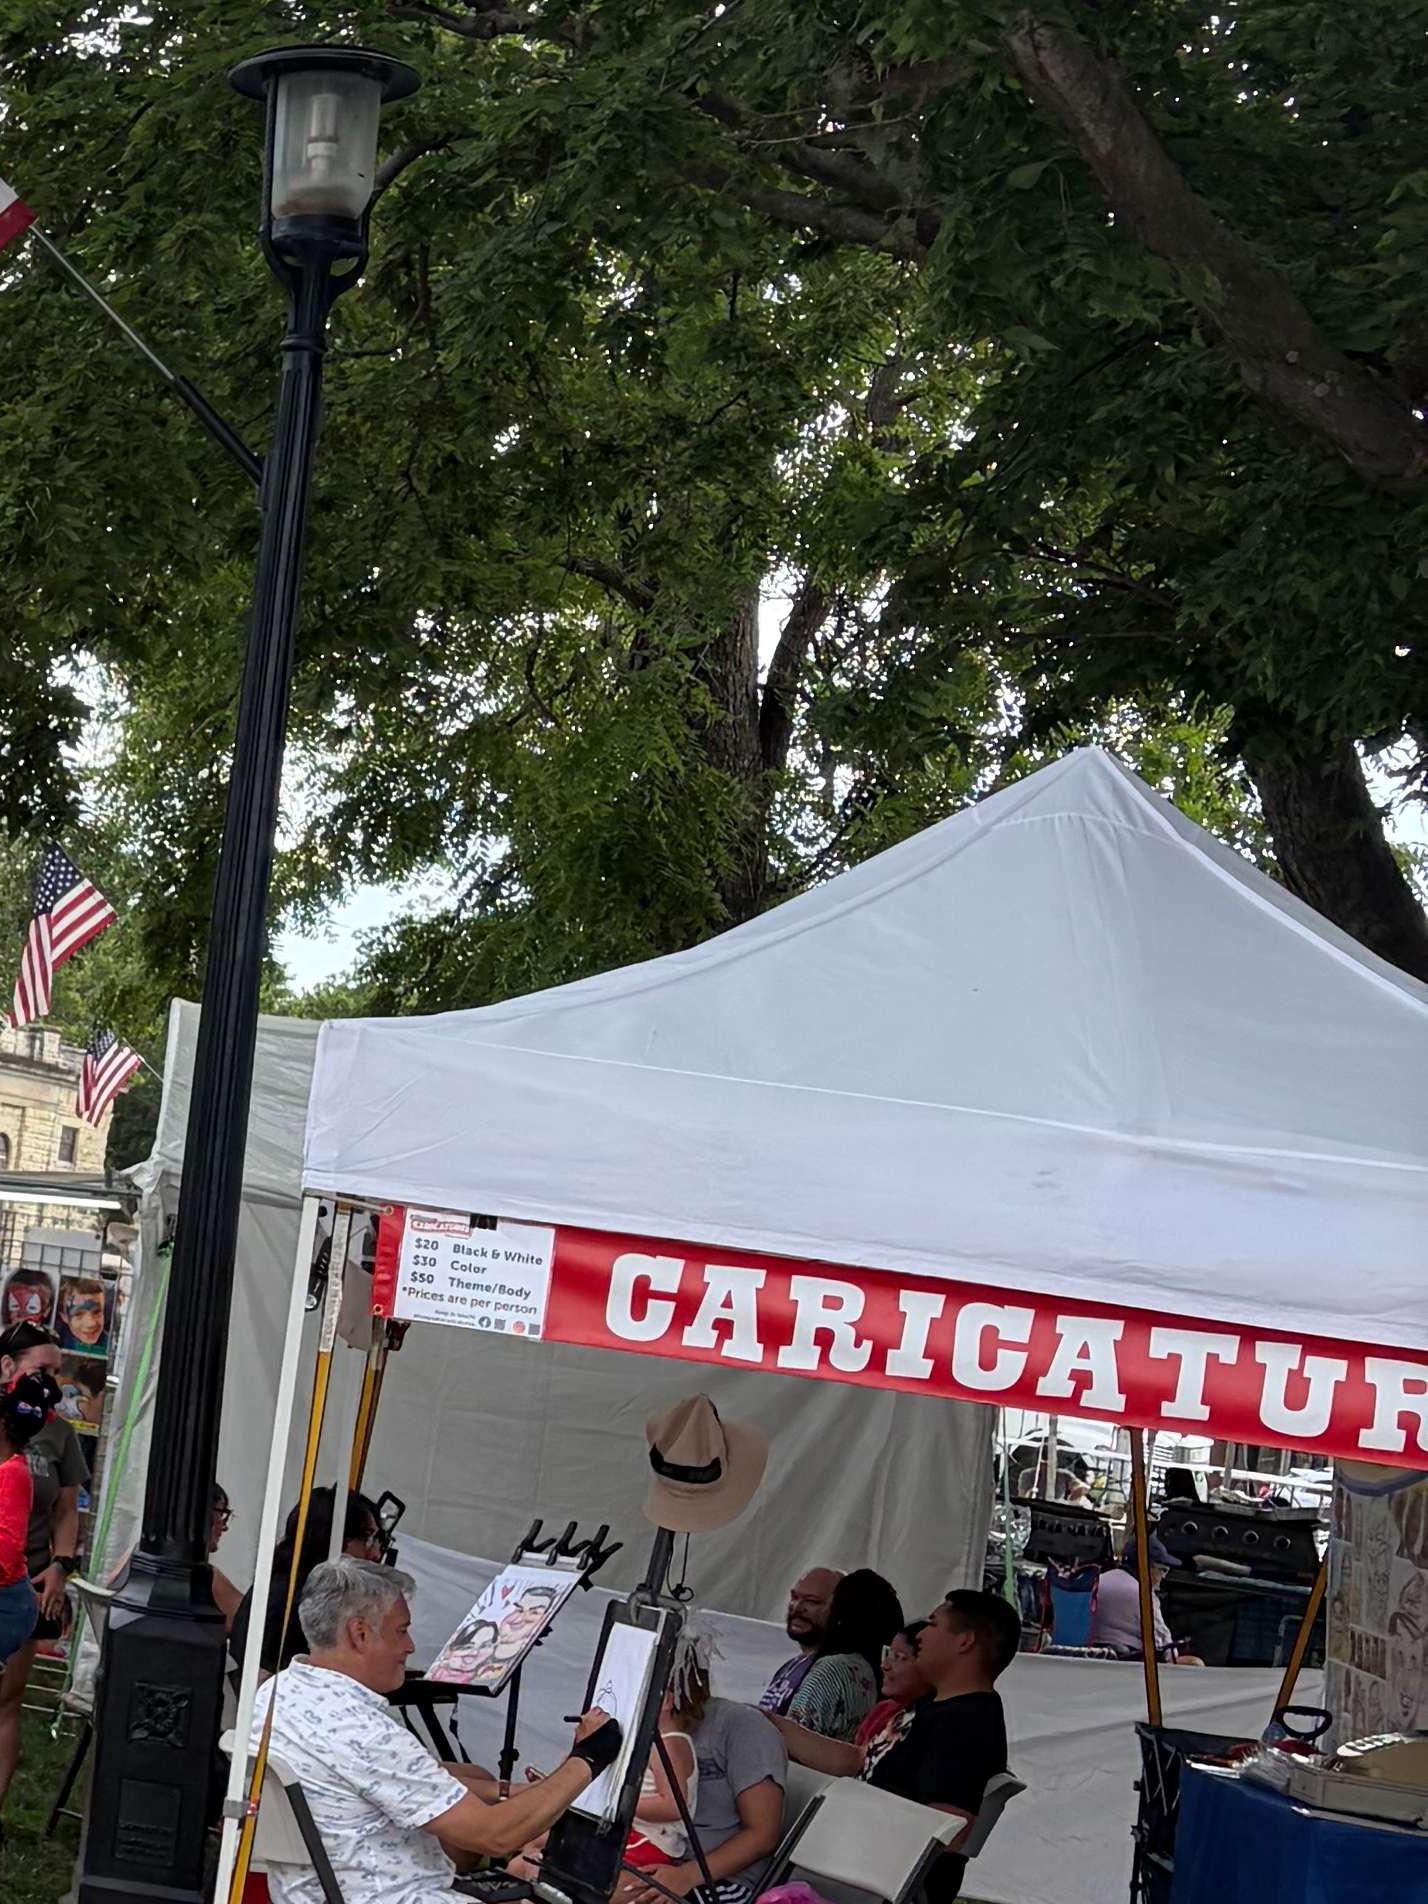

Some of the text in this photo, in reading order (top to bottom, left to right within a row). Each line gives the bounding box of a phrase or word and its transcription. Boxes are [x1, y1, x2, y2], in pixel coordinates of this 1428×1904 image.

[412, 1254, 487, 1275] $30 Color
[414, 1237, 544, 1266] $20 Black & White
[409, 1270, 532, 1301] $50 Theme/Body
[447, 1295, 468, 1305] are
[469, 1297, 492, 1309] per
[493, 1300, 538, 1316] person
[604, 1252, 1428, 1453] CARICATUR
